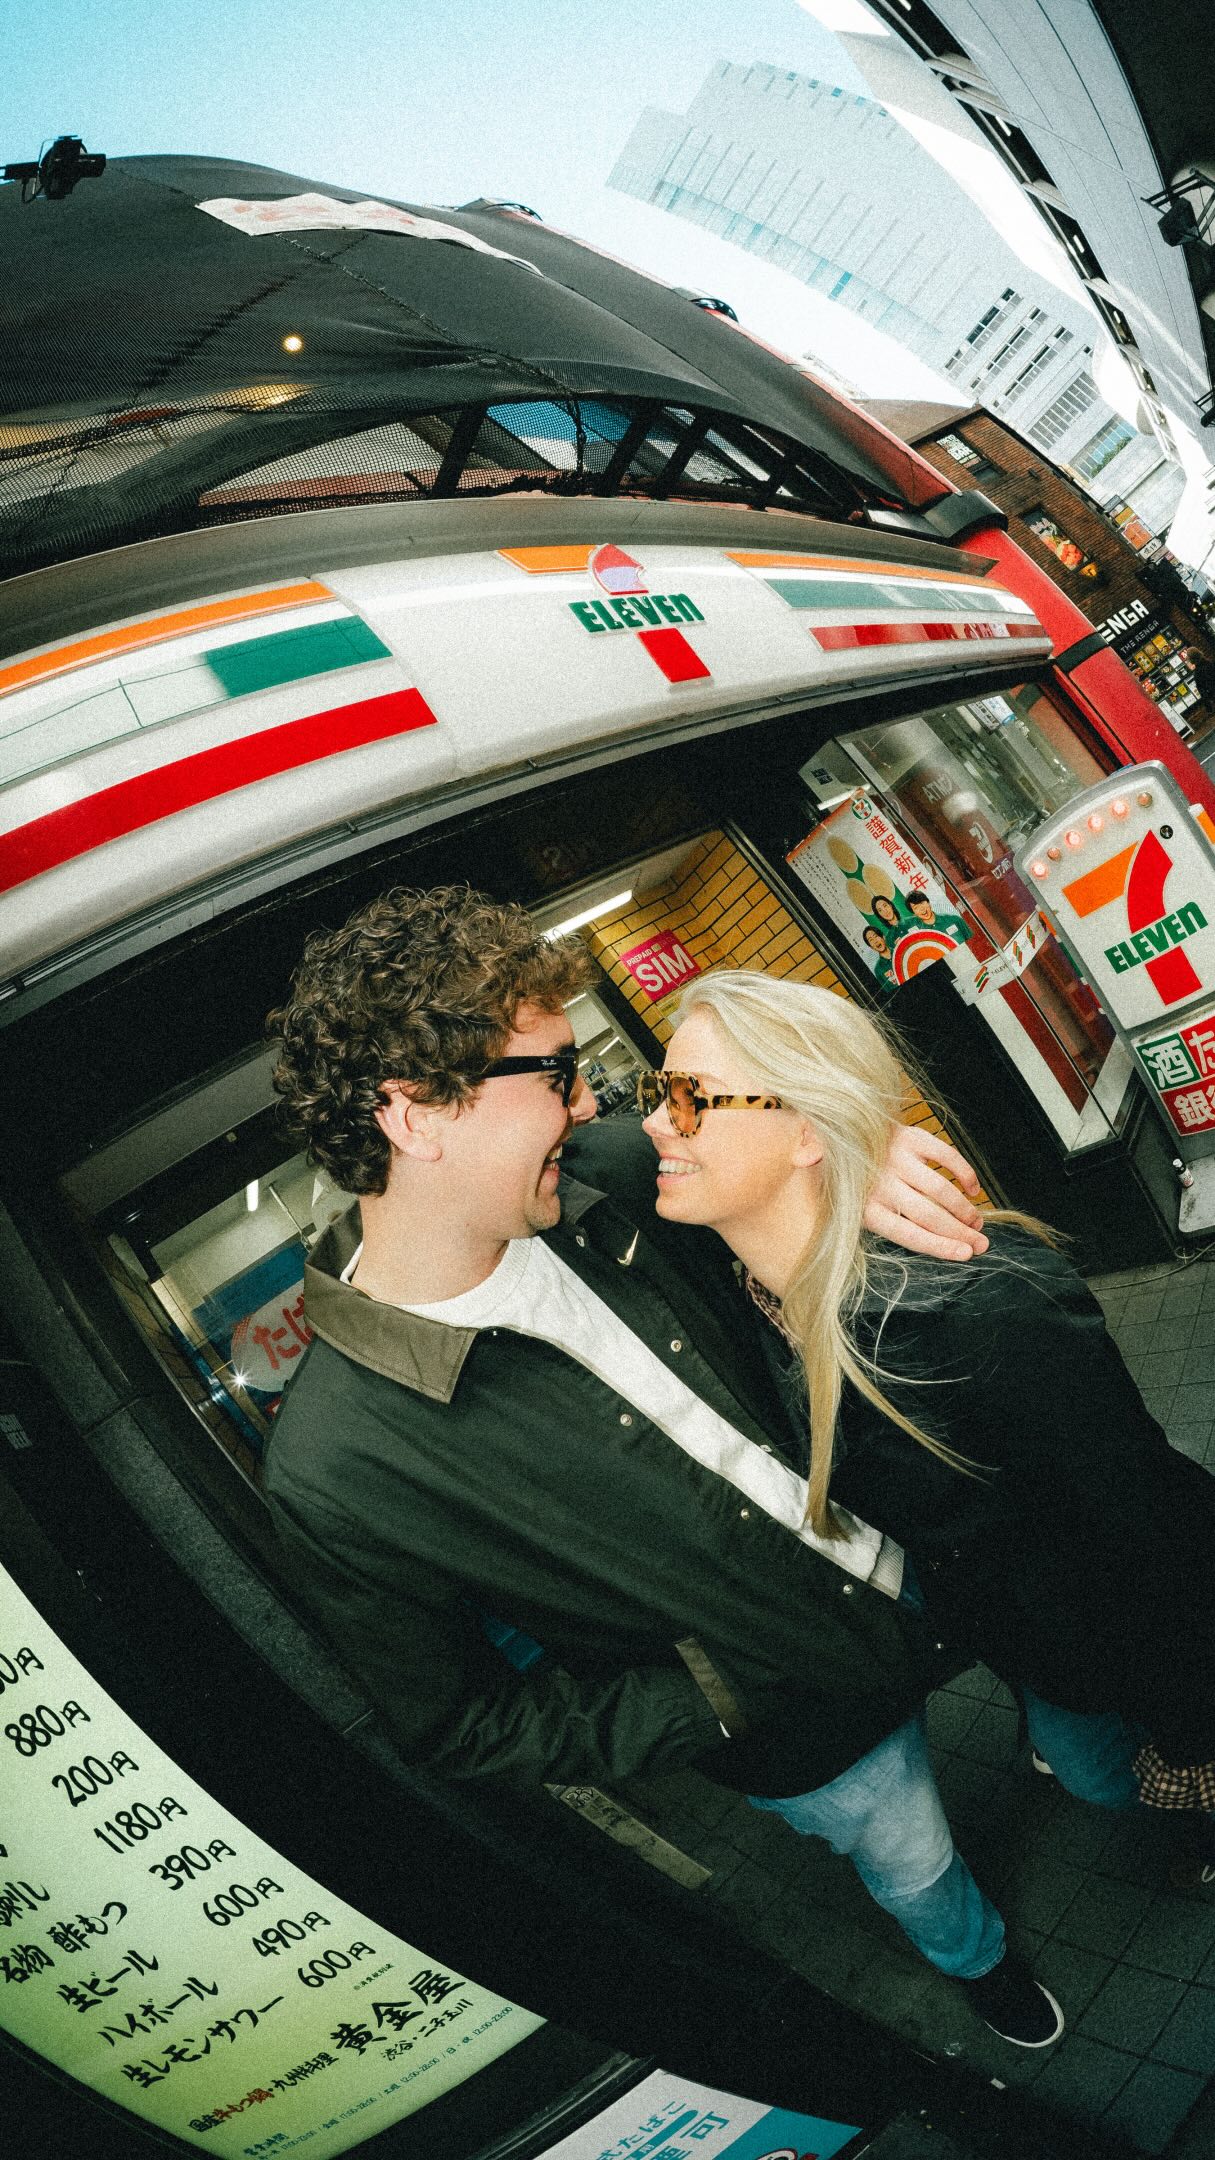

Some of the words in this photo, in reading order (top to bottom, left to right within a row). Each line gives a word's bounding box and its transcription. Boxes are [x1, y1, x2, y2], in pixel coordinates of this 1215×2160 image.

[1120, 639, 1136, 654] THE
[1134, 619, 1160, 642] RENGA
[865, 815, 929, 892] 謹賀新年
[626, 948, 653, 967] PREPAID
[635, 943, 695, 992] SIM
[1141, 1039, 1195, 1088] 酒
[1174, 1089, 1215, 1128] 銀
[0, 1647, 45, 1695] 0円
[4, 1700, 91, 1757] 880円
[51, 1750, 140, 1807] 200円
[0, 1881, 50, 1927] 刺し
[93, 1796, 189, 1854] 1180円
[46, 1901, 128, 1954] 酢もつ
[148, 1838, 237, 1891] 390円
[56, 1949, 159, 2013] 生ビール
[202, 1877, 285, 1927] 600円
[97, 1976, 219, 2047] ハイボール
[252, 1911, 332, 1958] 490円
[120, 1995, 285, 2089] 生レモンサワー
[297, 1941, 377, 1989] 600円
[329, 1969, 467, 2056] 黄金屋
[382, 1998, 475, 2061] 渋谷・二子玉川
